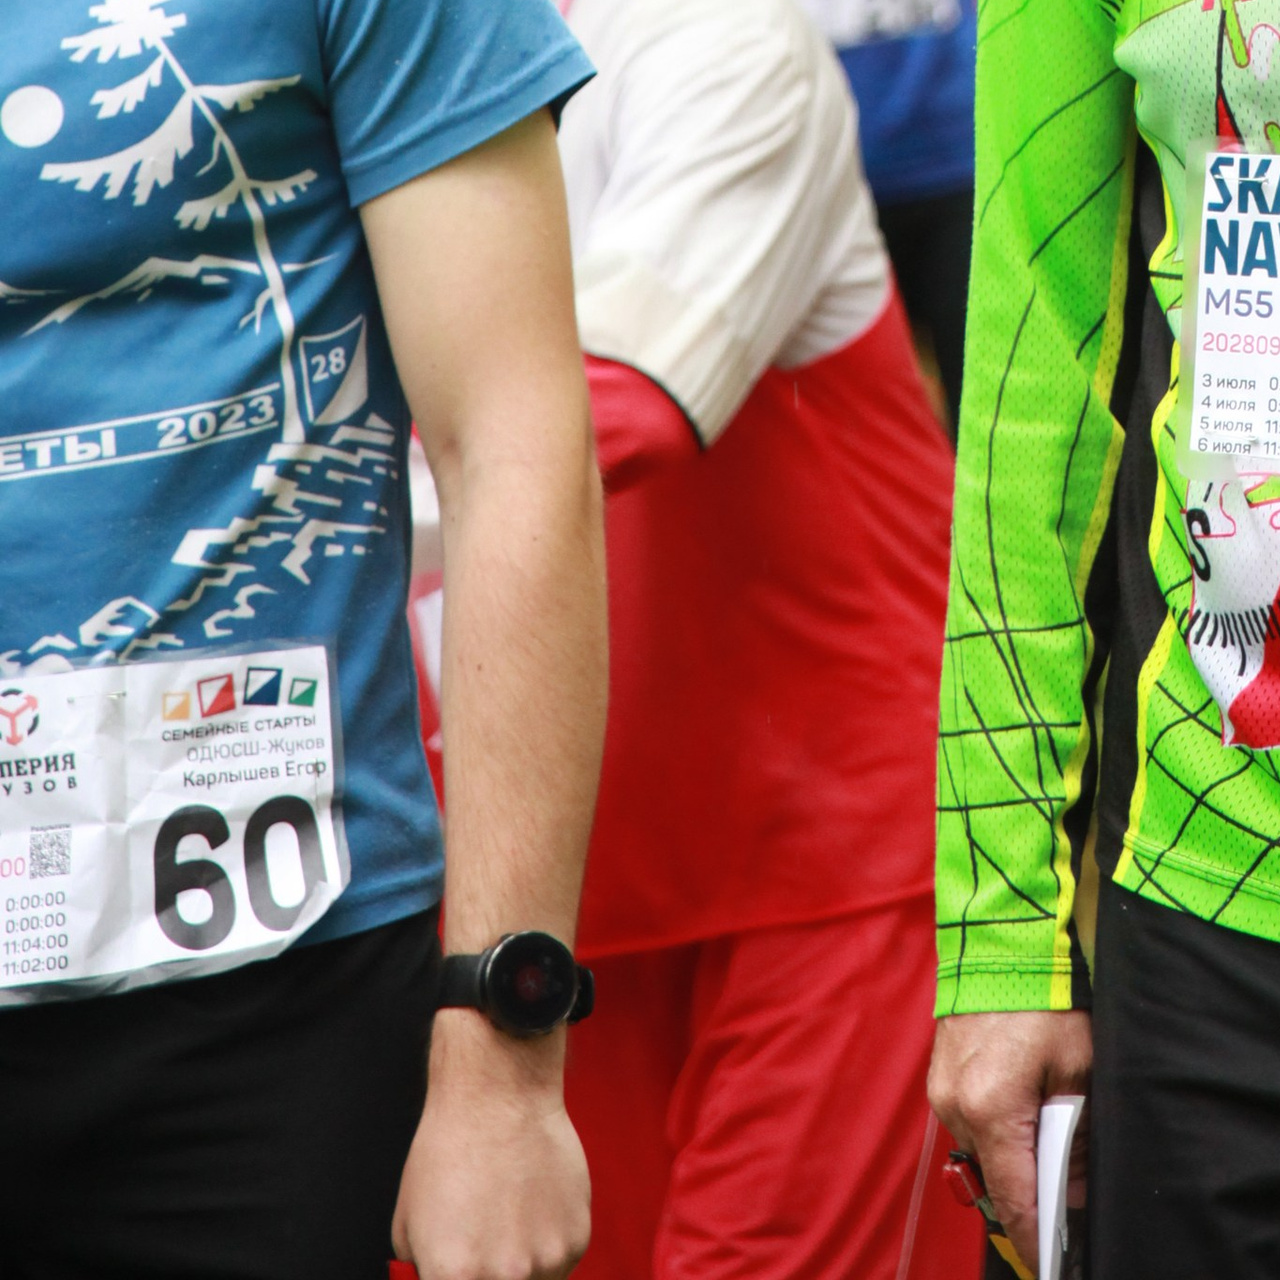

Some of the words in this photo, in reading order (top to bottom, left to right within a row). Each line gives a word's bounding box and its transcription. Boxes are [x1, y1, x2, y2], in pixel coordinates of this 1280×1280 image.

[311, 346, 346, 383] 28
[1202, 373, 1212, 387] 3
[1217, 378, 1256, 390] июля
[1201, 395, 1212, 409] 4
[1216, 399, 1256, 412] июля
[156, 394, 276, 449] 2023
[1200, 416, 1210, 429] 5
[1213, 420, 1253, 433] июля
[1198, 437, 1208, 452] 6
[1212, 441, 1252, 455] июля
[162, 720, 249, 742] СЕМЕЙНЫЕ
[255, 715, 316, 732] СТАРТЫ
[187, 736, 325, 763] ОДЮСШ-Жуков
[184, 765, 280, 789] Карлышев
[286, 759, 327, 779] Егор
[154, 795, 328, 951] 60
[6, 891, 66, 912] 0:00:00
[6, 912, 67, 934] 0:00:00
[3, 933, 69, 955] 11:04:00
[3, 955, 69, 976] 11:02:00
